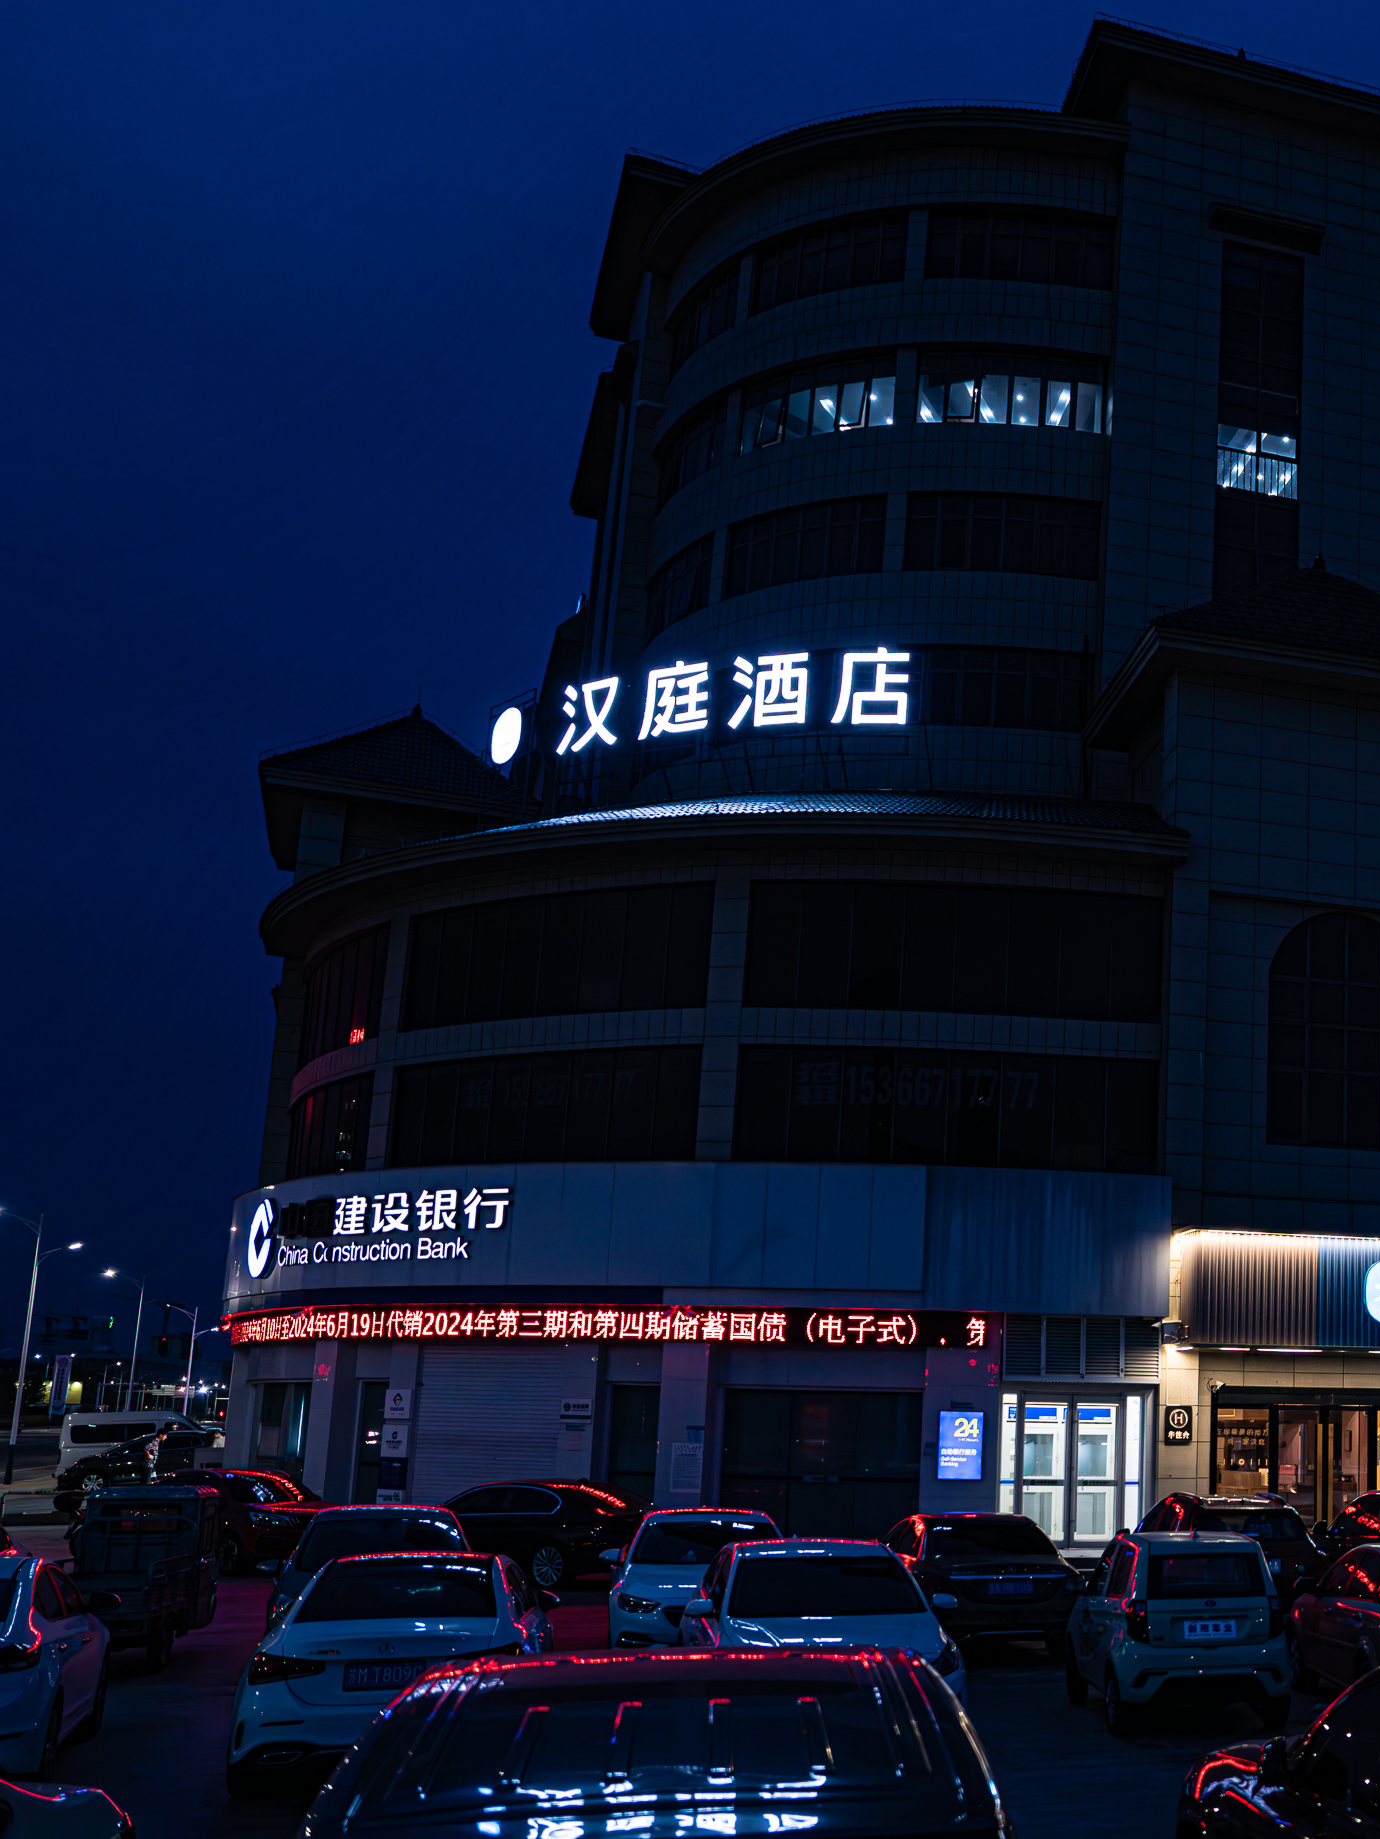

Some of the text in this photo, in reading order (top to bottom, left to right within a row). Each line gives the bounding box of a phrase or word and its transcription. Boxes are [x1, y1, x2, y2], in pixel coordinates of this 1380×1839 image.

[555, 646, 911, 756] 汉庭酒店
[845, 1065, 1040, 1110] 15366717777
[277, 1246, 309, 1267] China
[416, 1235, 470, 1260] Bank
[954, 1417, 980, 1438] 24
